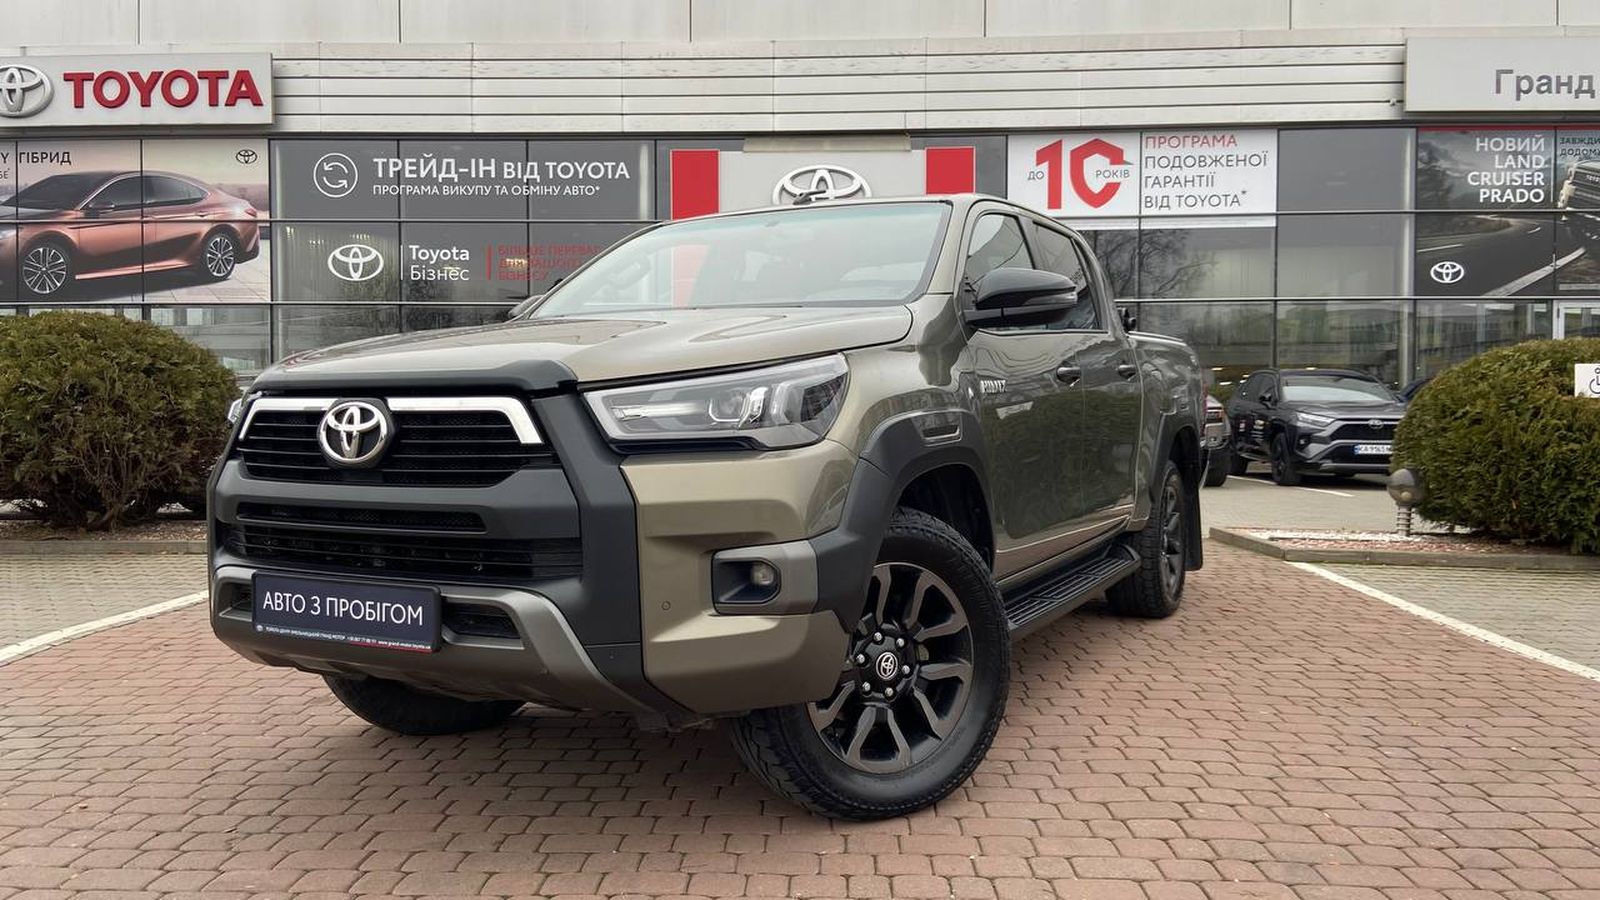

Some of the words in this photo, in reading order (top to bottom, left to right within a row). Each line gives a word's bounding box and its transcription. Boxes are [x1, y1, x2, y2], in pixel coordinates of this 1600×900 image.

[63, 69, 264, 110] TOYOTA
[1495, 69, 1596, 101] Гранд
[1145, 134, 1238, 150] ПРОГРАМА
[1476, 135, 1545, 152] НОВИЙ
[19, 151, 72, 166] ГІБРИД
[1144, 151, 1269, 171] ПОДОВЖЕНОЇ
[1494, 155, 1544, 169] LAND
[373, 154, 496, 182] ТРЕЙД-ІН
[503, 162, 541, 183] ВІД
[545, 161, 630, 180] TOYOTA
[1027, 170, 1045, 181] ДО
[1095, 168, 1130, 180] РОКІВ
[1144, 171, 1216, 190] ГАРАНТІЇ
[1467, 171, 1545, 186] CRUISER
[373, 184, 440, 197] ПРОГРАМА
[442, 184, 492, 197] ВИКУПУ
[494, 184, 509, 196] ТА
[511, 184, 561, 196] ОБМІНУ
[1480, 188, 1545, 203] PRADO
[1145, 195, 1171, 210] ВІД
[409, 245, 470, 265] Toyota
[409, 264, 470, 281] Бізнес
[262, 591, 306, 614] АВТО
[310, 595, 321, 615] З
[326, 597, 424, 626] ПРОБІГОМ
